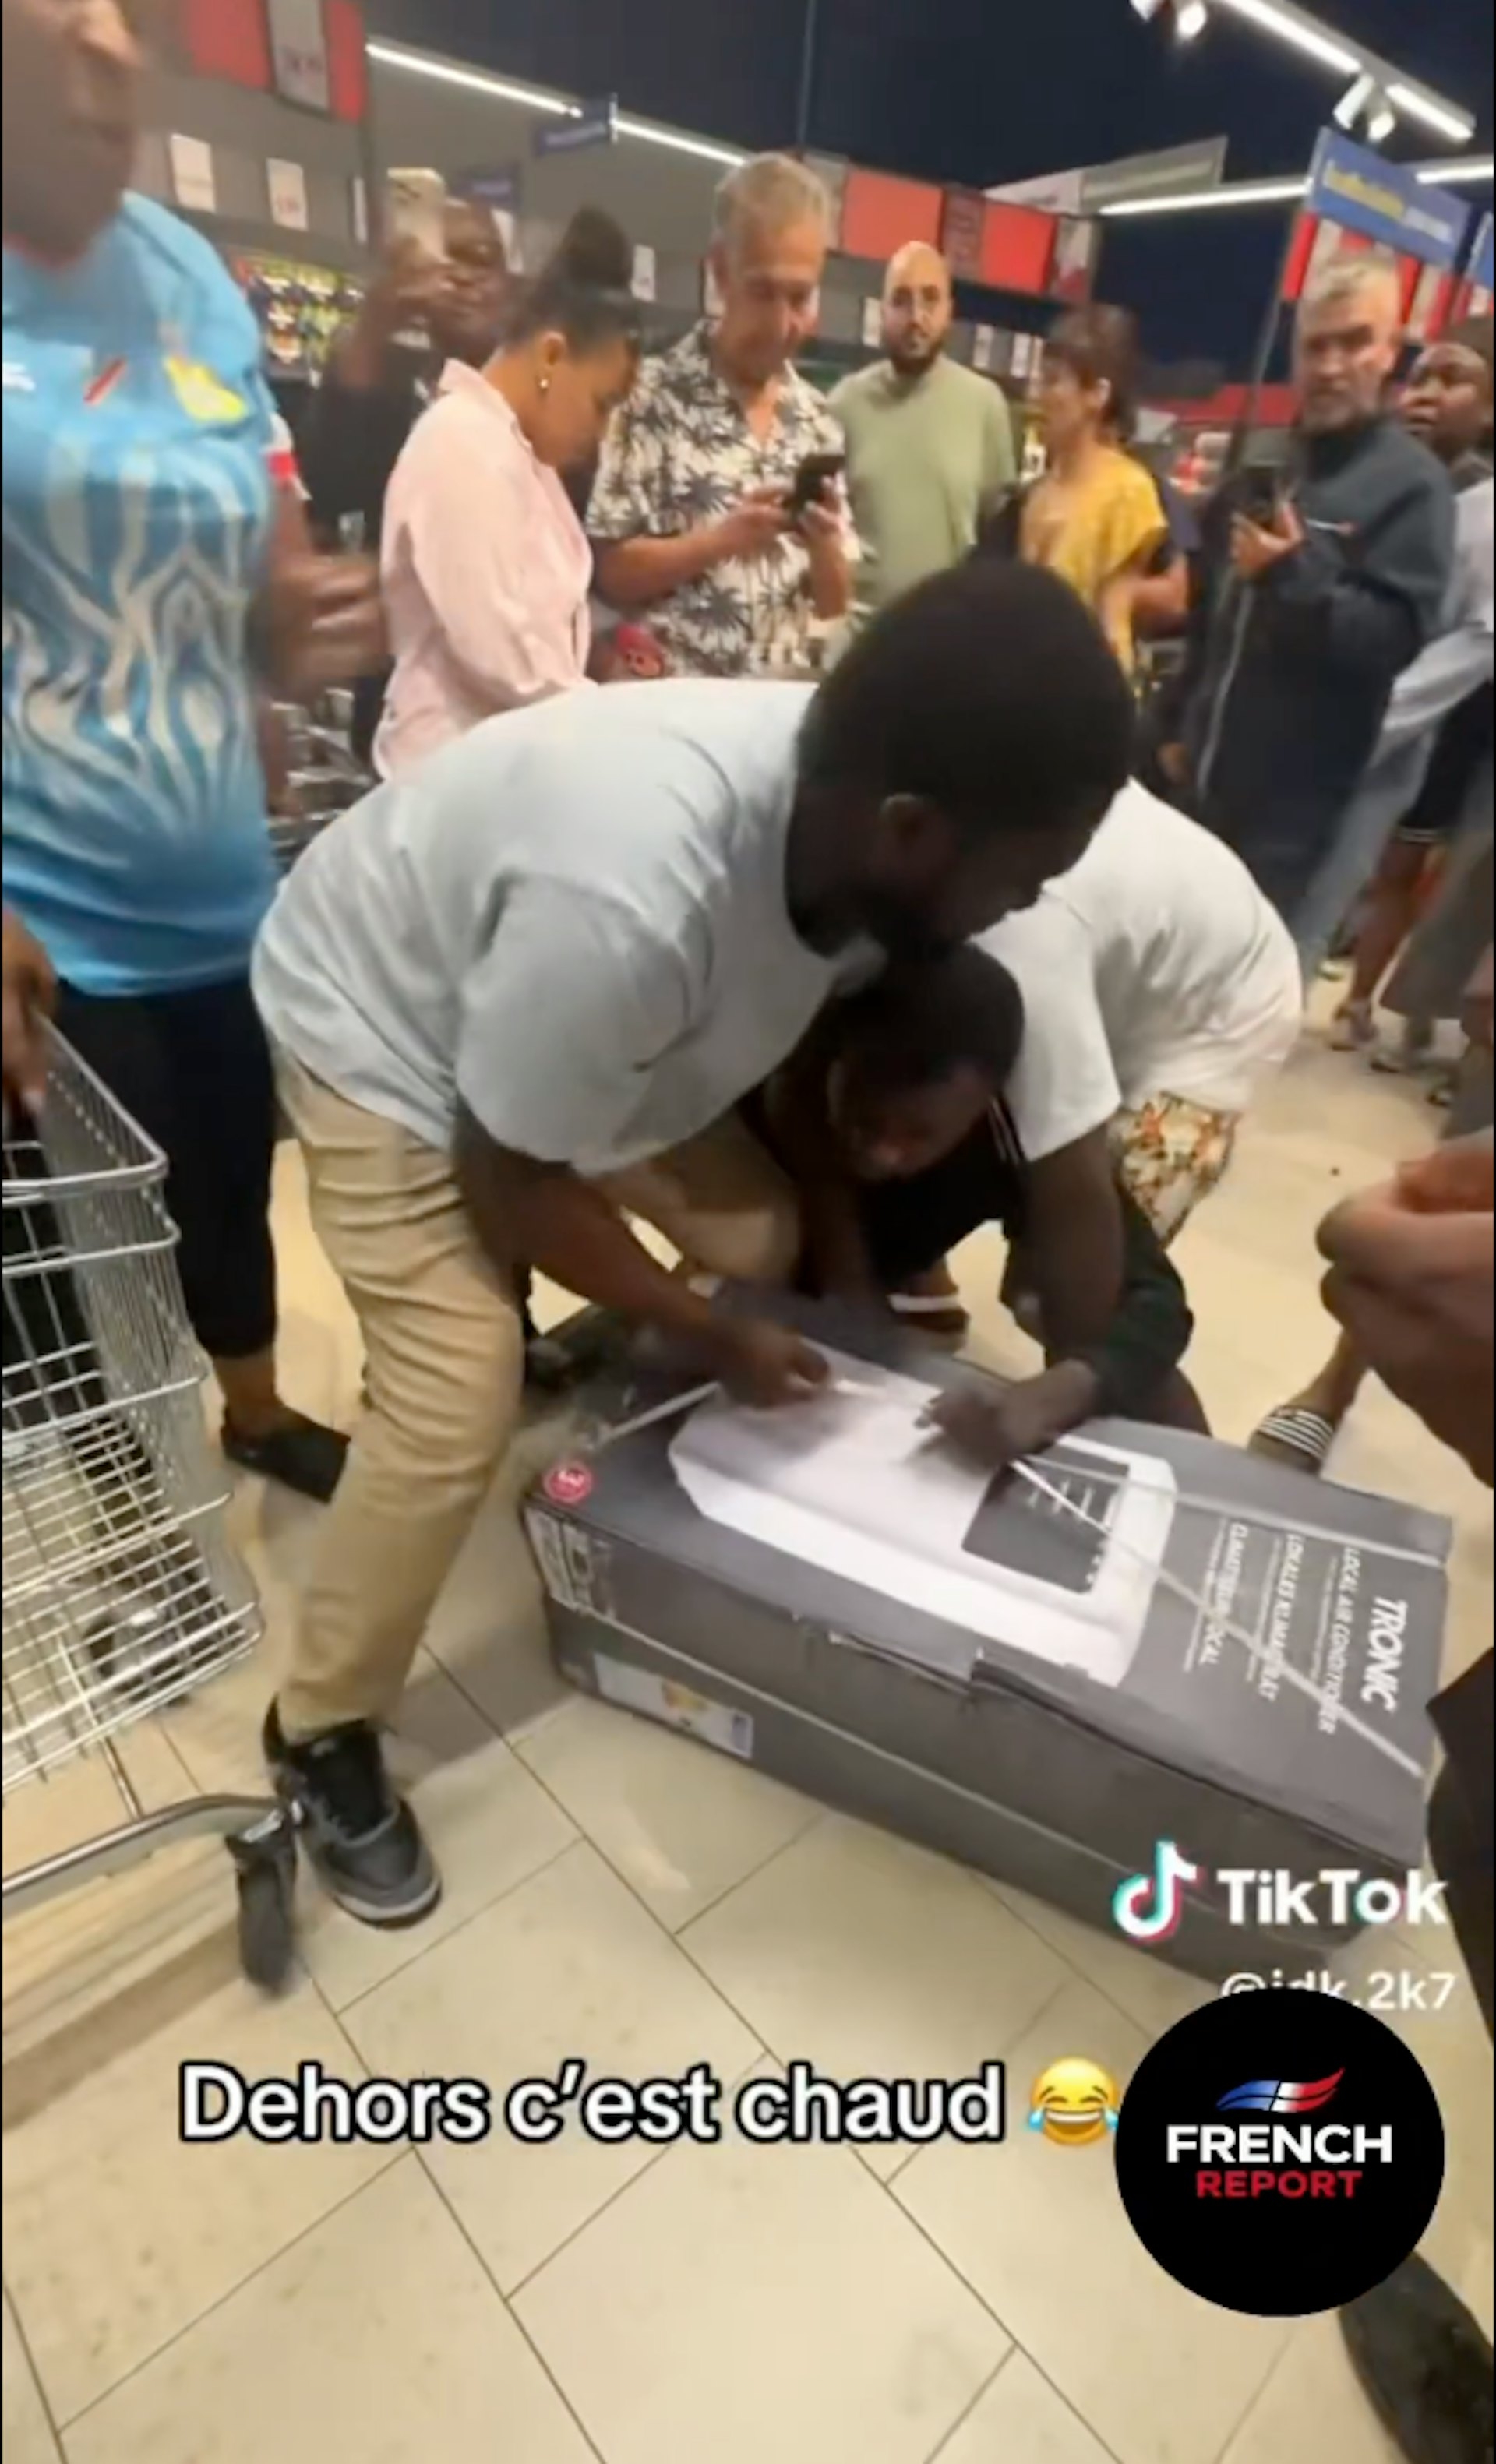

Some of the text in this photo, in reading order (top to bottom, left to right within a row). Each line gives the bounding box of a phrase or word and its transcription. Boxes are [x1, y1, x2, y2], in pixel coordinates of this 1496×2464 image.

[1335, 1593, 1354, 1623] AIR
[1338, 1545, 1361, 1592] LOCAL
[1318, 1623, 1351, 1735] CONDITIOER
[1360, 1596, 1409, 1713] TRONIC
